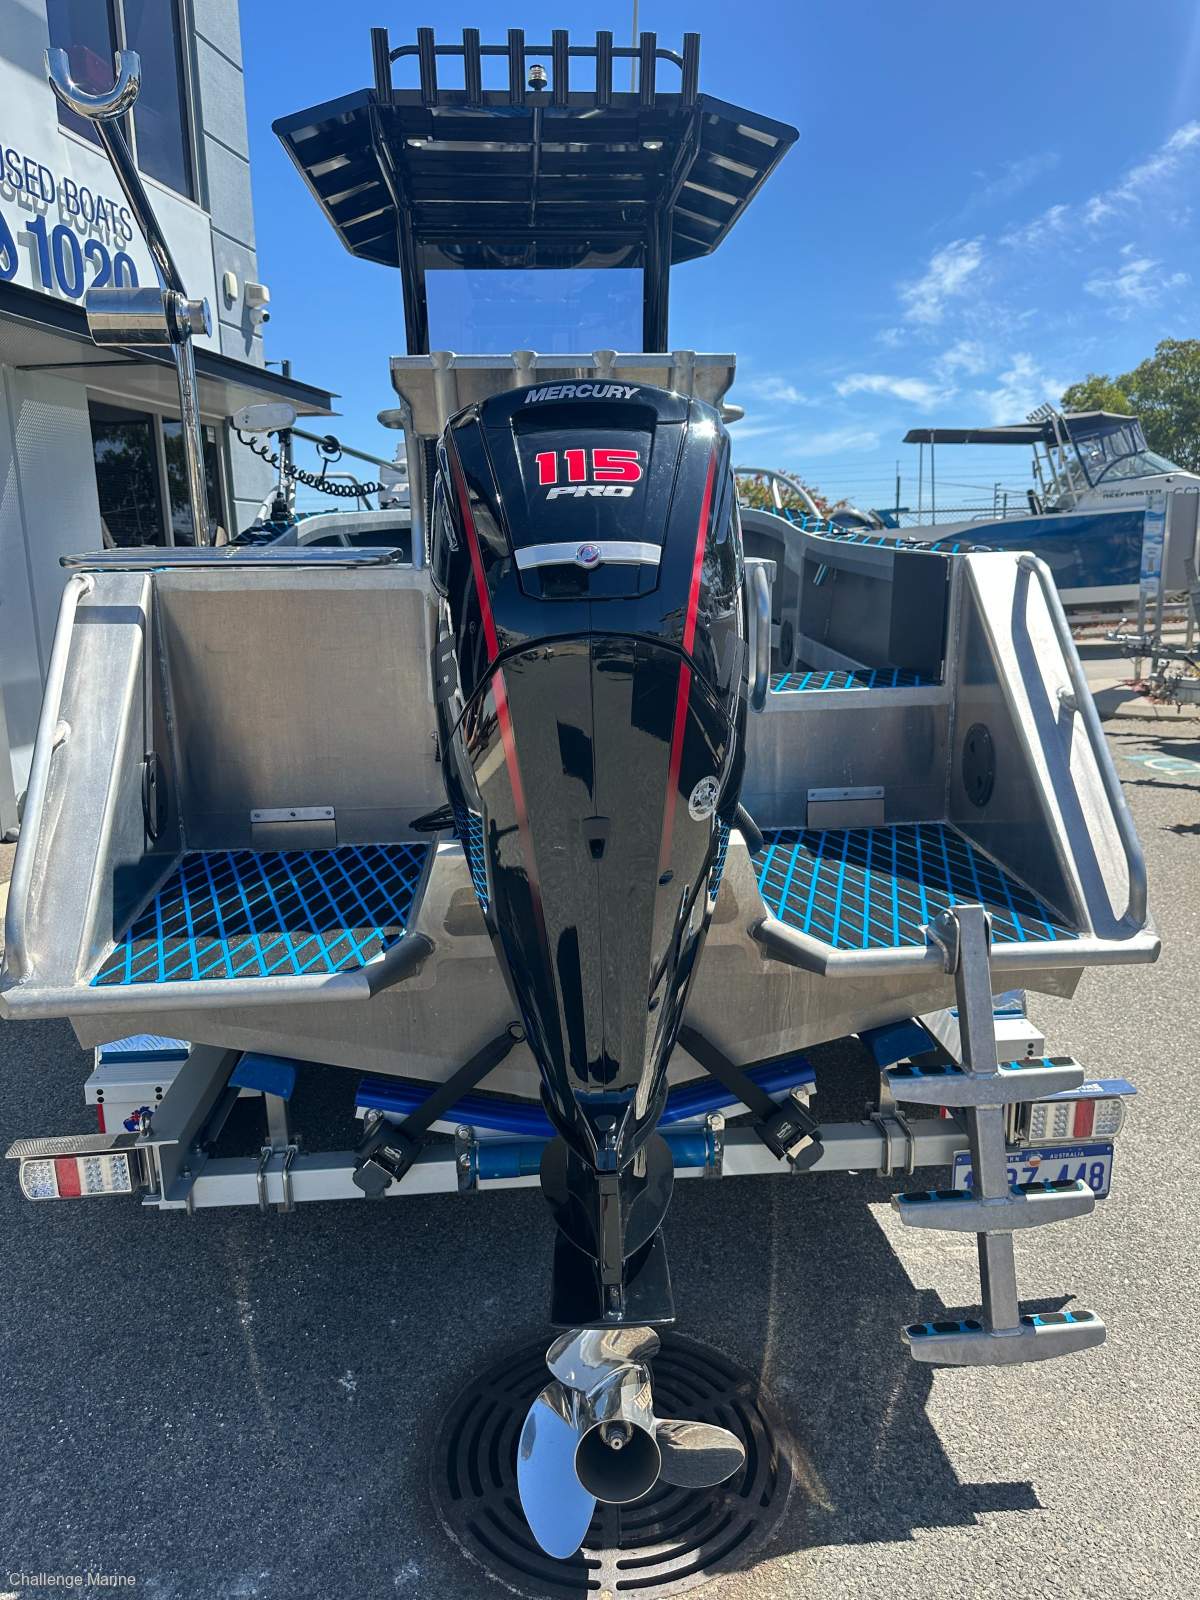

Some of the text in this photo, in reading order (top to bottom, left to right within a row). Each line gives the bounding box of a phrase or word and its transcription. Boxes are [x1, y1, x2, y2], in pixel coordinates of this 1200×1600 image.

[64, 177, 133, 241] BOATS
[524, 384, 640, 403] MERCURY
[536, 449, 642, 485] 115
[546, 485, 634, 500] PRO
[1050, 1151, 1085, 1160] AUSTRALIA
